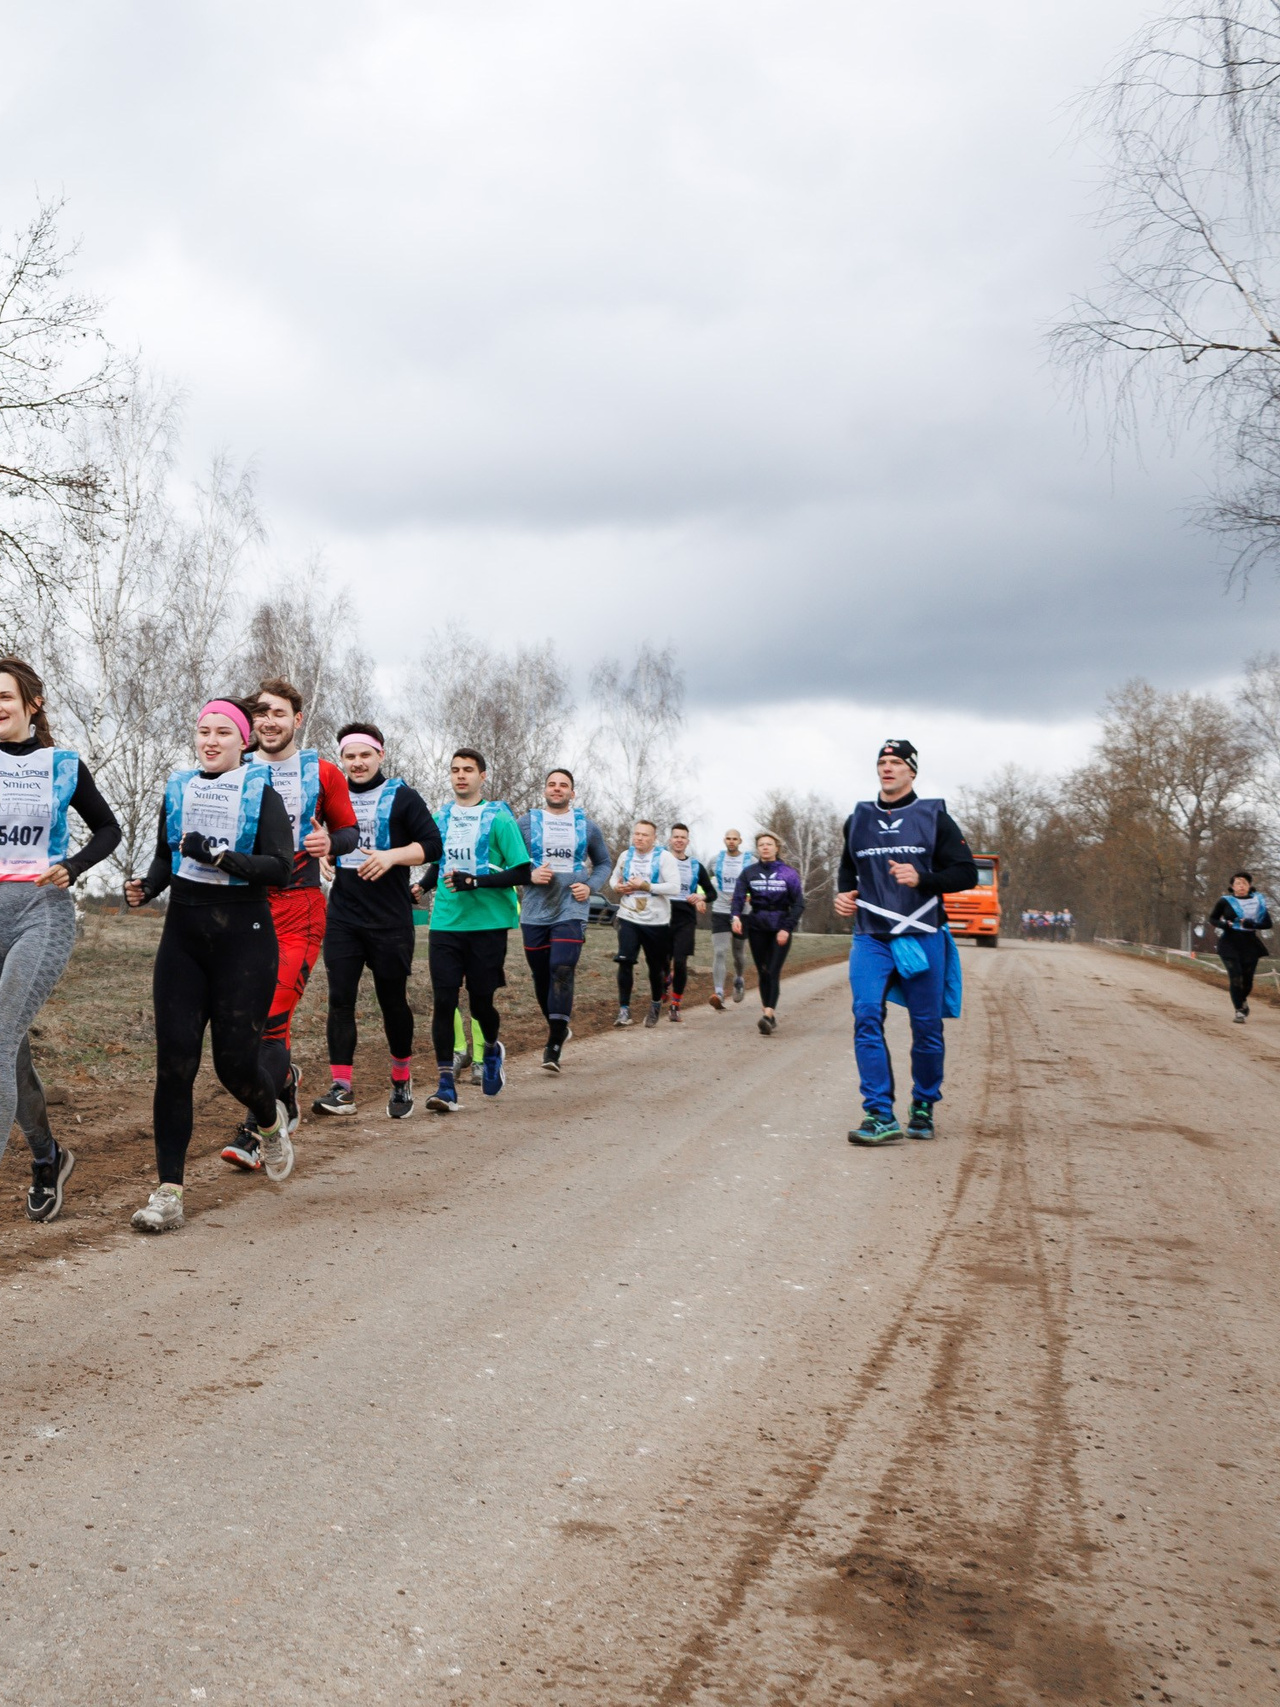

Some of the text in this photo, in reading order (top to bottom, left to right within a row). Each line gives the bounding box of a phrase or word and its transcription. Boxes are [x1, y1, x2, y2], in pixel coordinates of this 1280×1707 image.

[2, 779, 41, 790] Sminex
[193, 790, 230, 802] Sminex
[448, 847, 471, 860] 5411
[855, 846, 926, 858] ИНСТРУКТОР
